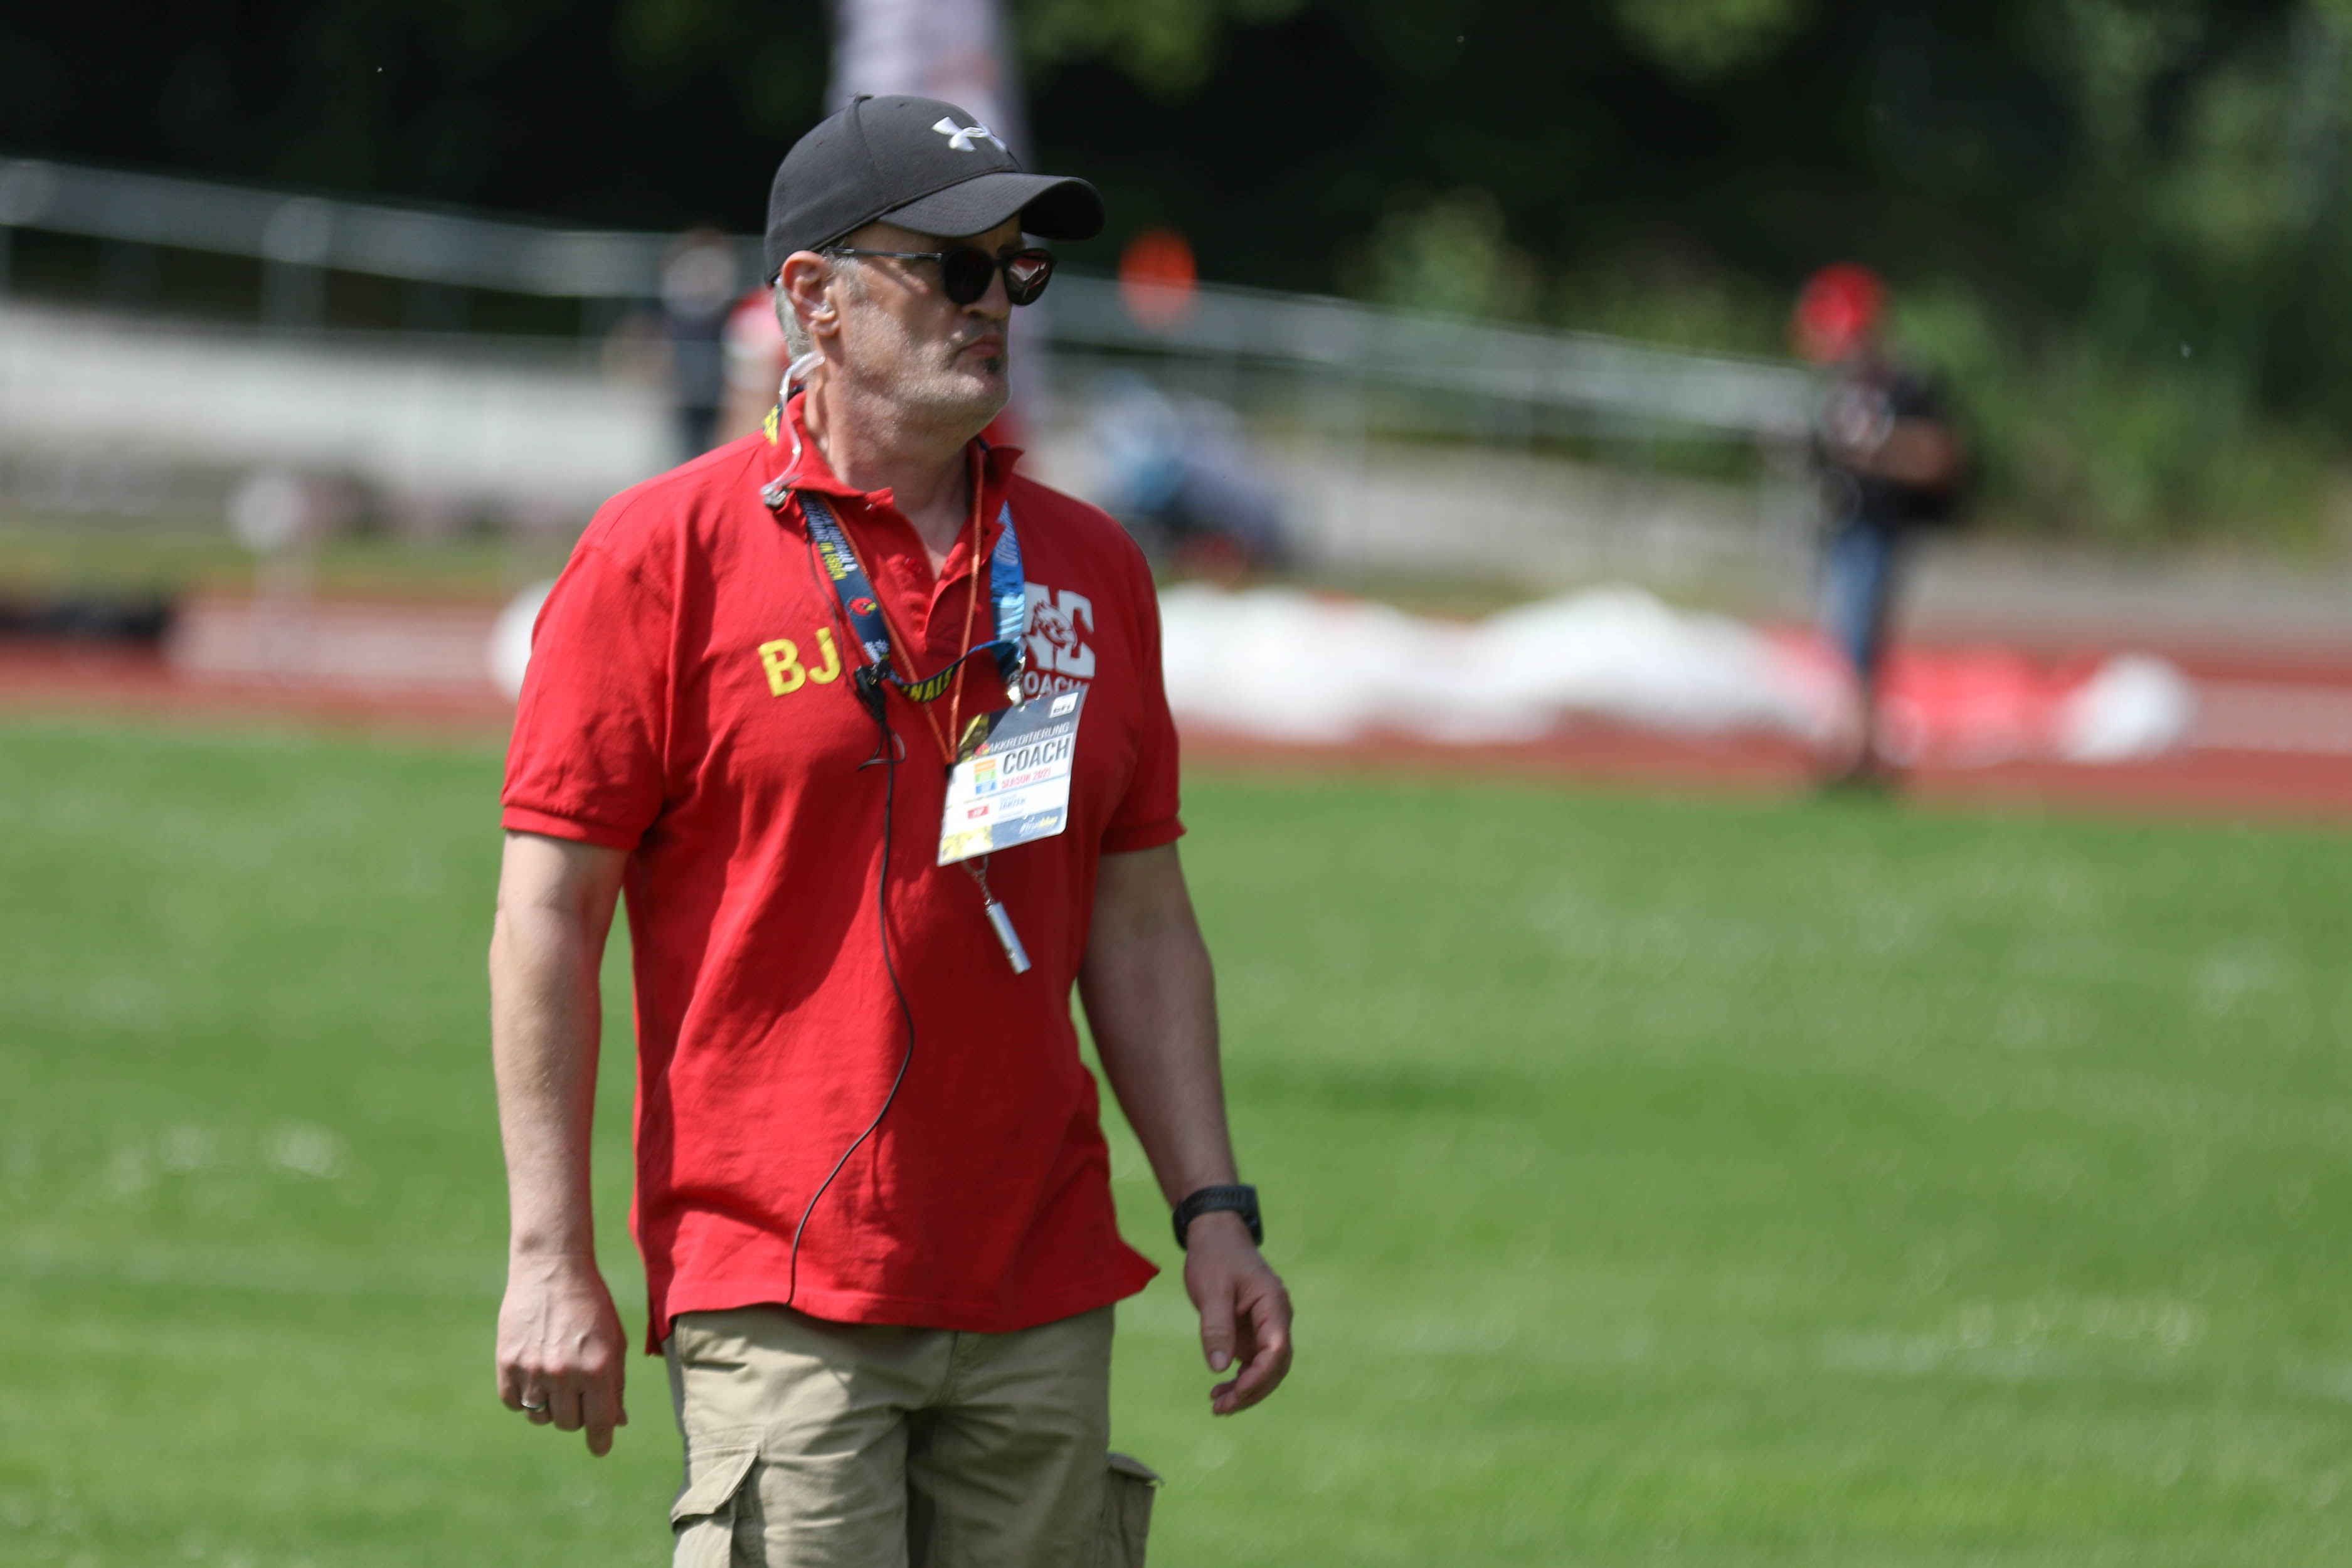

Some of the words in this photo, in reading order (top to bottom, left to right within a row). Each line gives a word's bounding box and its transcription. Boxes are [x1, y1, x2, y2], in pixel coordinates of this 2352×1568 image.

[758, 627, 841, 698] BJ
[988, 722, 1069, 753] AKKREDITIERUNG
[1003, 736, 1070, 775] COACH
[1002, 773, 1031, 790] SEASON
